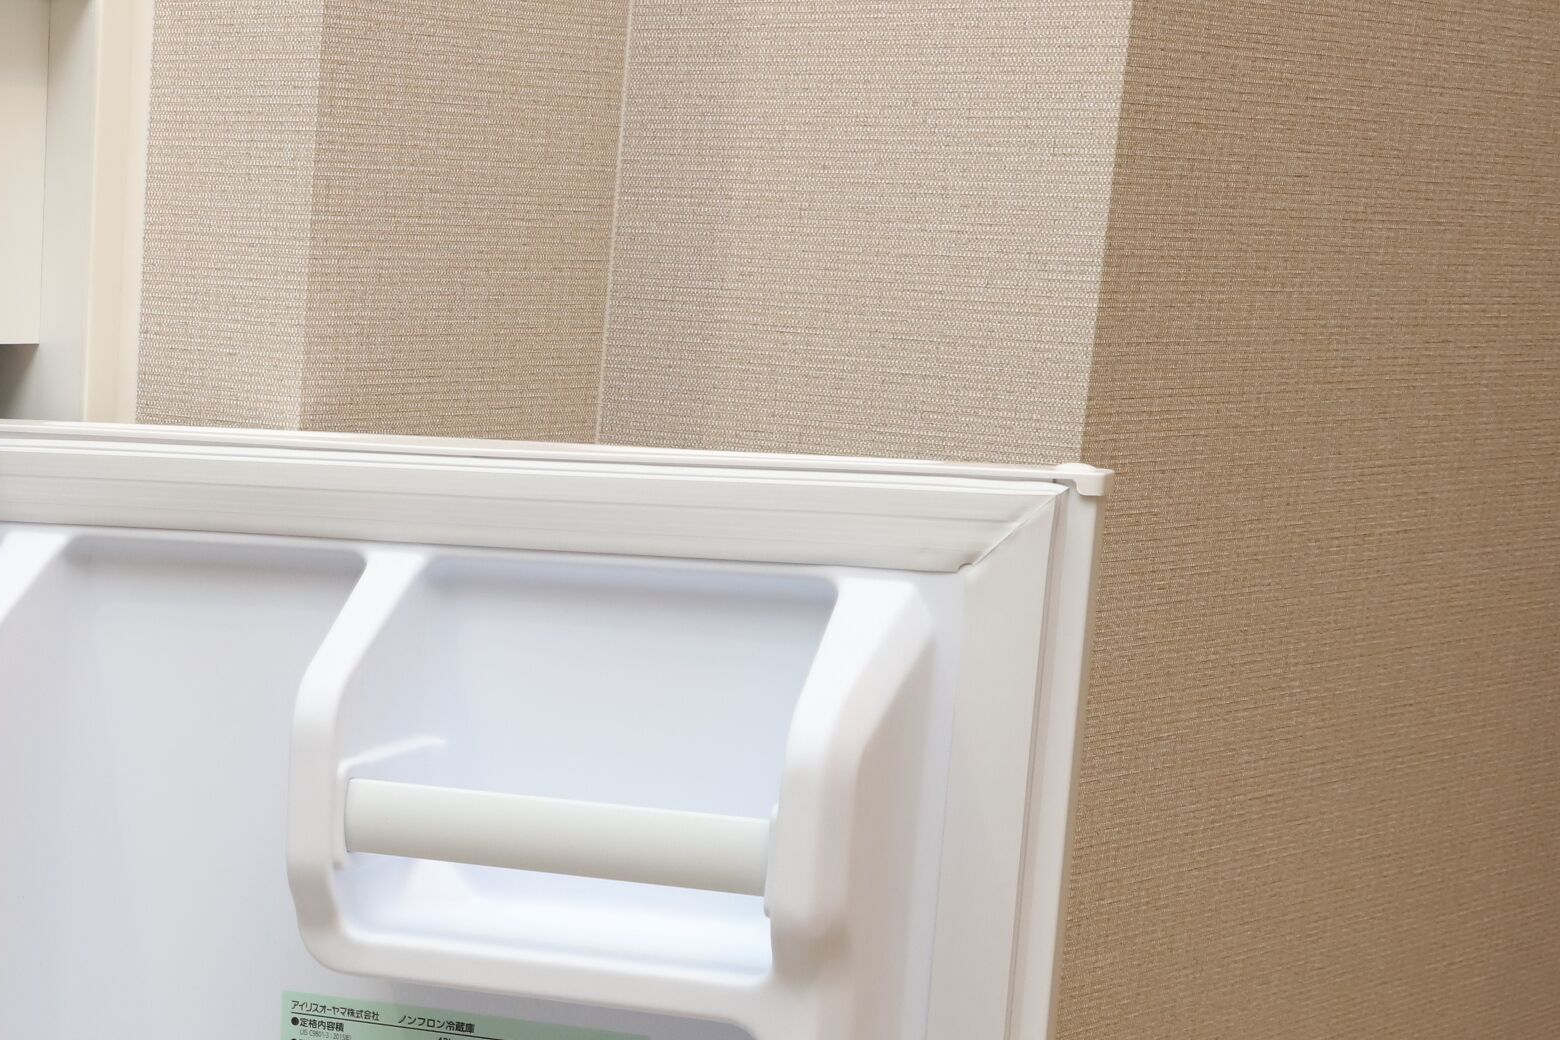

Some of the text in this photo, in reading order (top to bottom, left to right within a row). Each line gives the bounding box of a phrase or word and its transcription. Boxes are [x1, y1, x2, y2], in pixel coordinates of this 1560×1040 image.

[291, 1000, 380, 1021] アイリスオーヤマ株式会社
[398, 1015, 475, 1034] ノンフロン冷蔵庫
